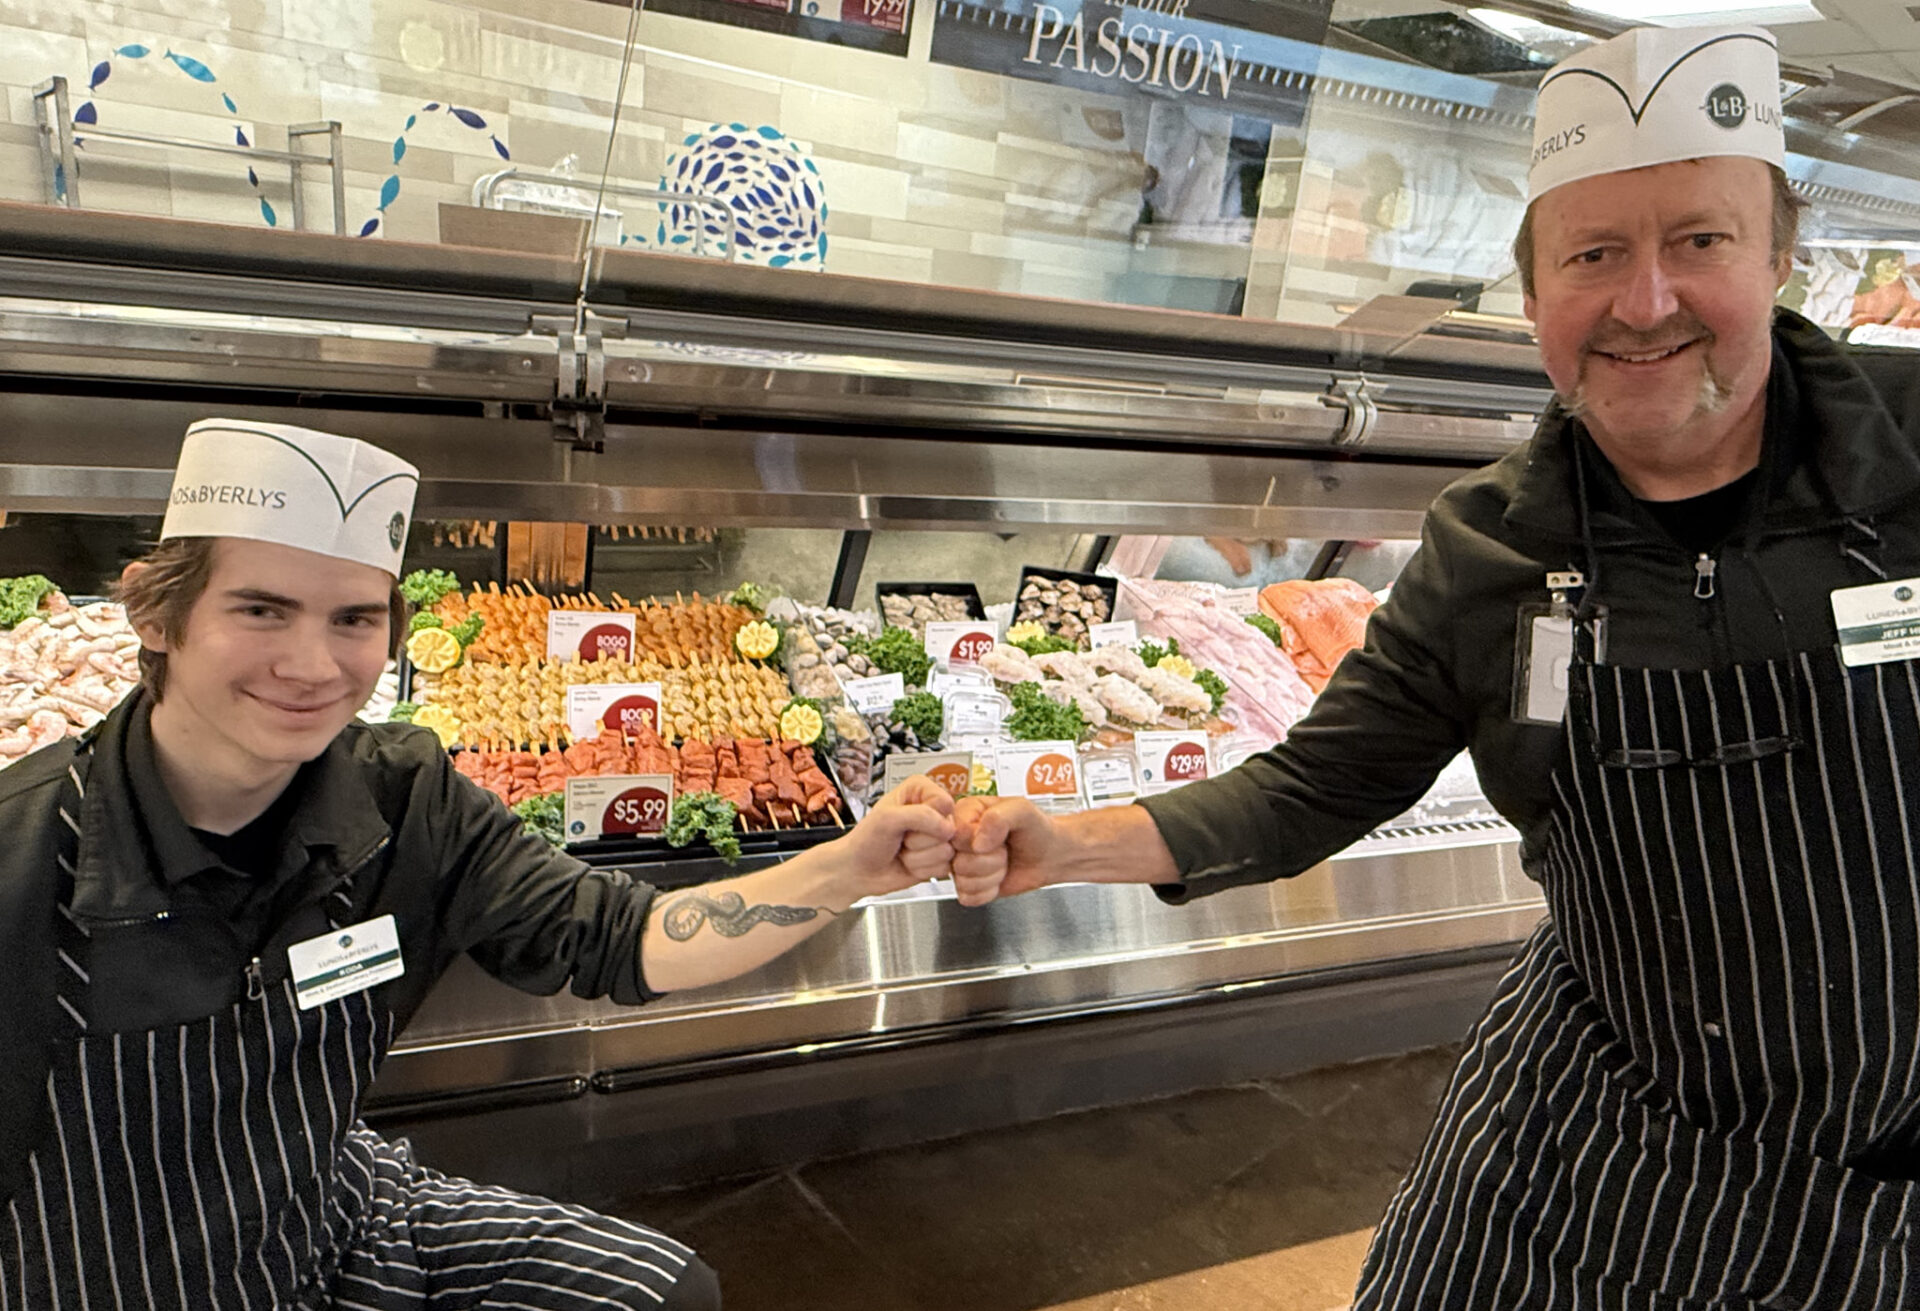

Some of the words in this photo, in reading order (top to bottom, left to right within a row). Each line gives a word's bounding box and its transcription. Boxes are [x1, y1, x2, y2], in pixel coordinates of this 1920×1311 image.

[1022, 3, 1243, 99] PASSION
[597, 634, 628, 648] BOGO
[1881, 628, 1908, 640] JEFF
[958, 640, 993, 660] $1.99
[1033, 763, 1072, 785] $2.49
[1170, 754, 1205, 774] $29.99
[614, 798, 665, 824] $5.99
